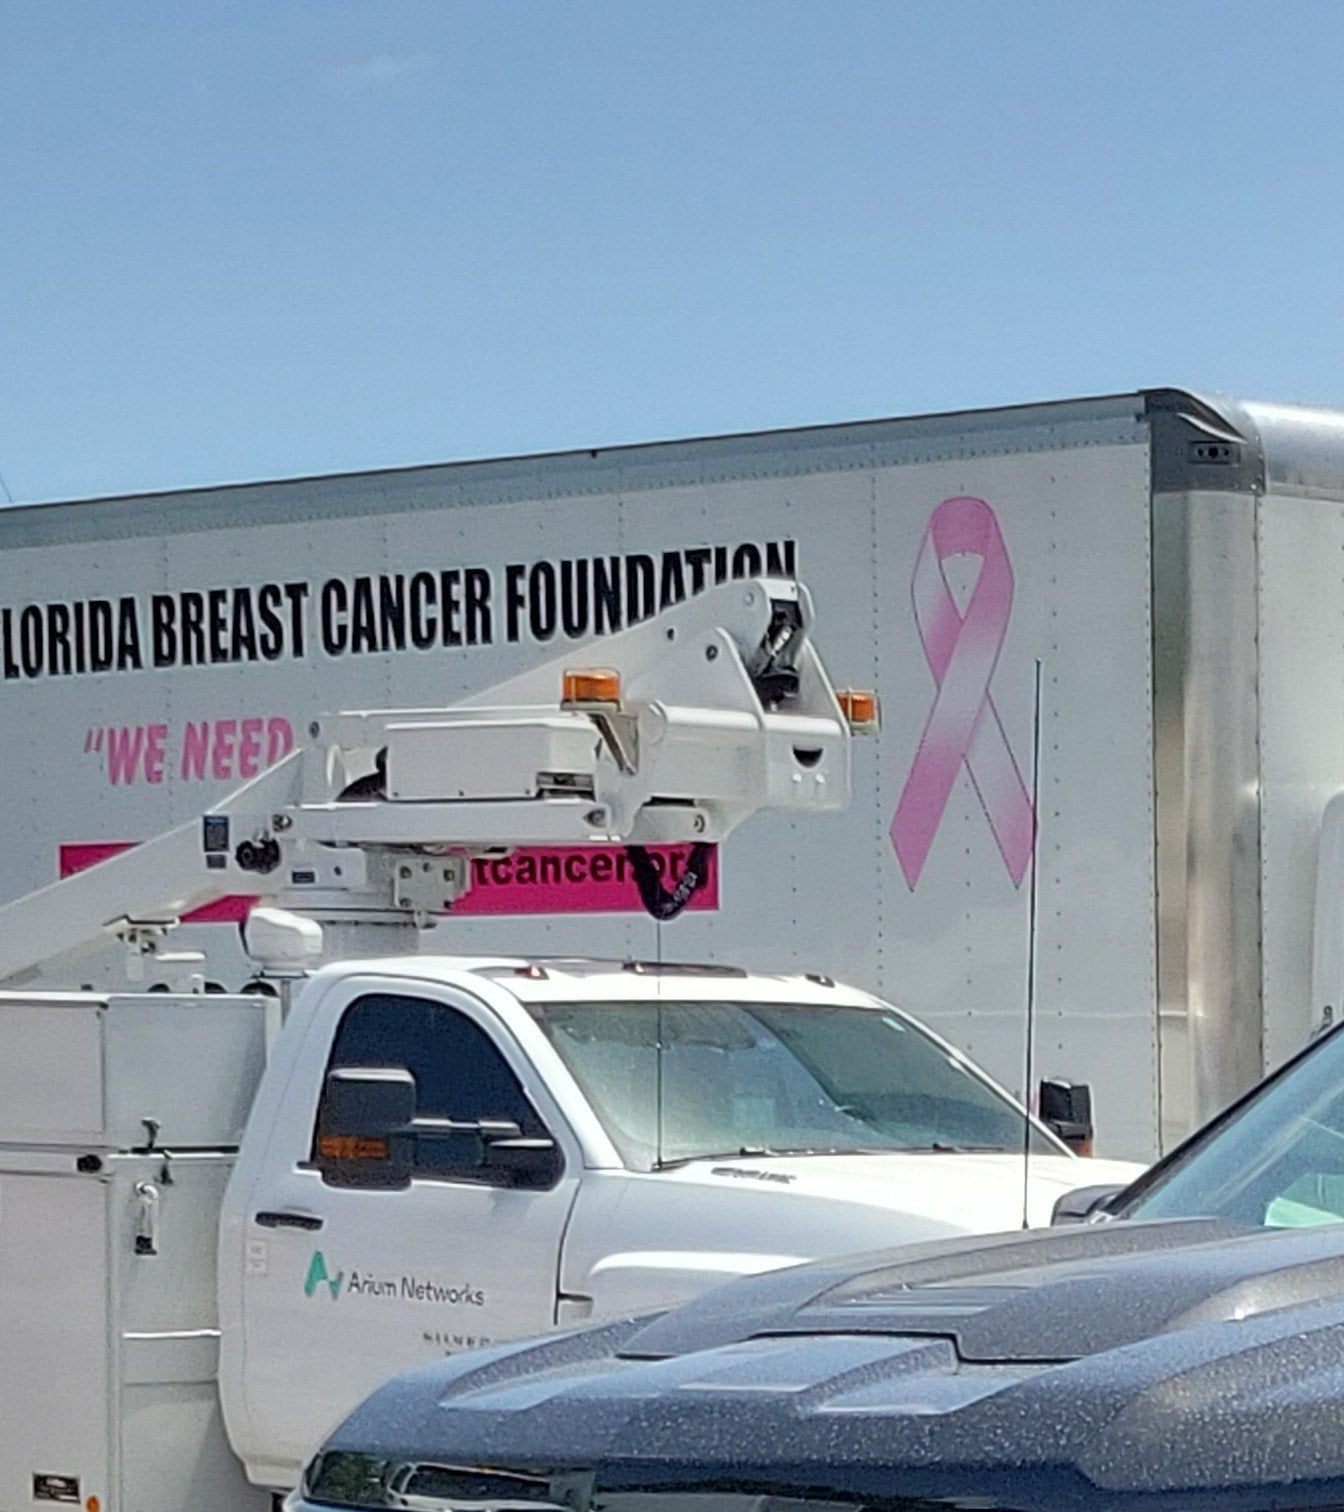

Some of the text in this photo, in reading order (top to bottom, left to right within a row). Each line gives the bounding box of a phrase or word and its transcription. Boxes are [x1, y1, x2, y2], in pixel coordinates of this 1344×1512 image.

[151, 582, 309, 668] BREAST
[320, 567, 493, 658] CANCER
[181, 716, 294, 781] NEED
[347, 1271, 484, 1306] Arium Networks
